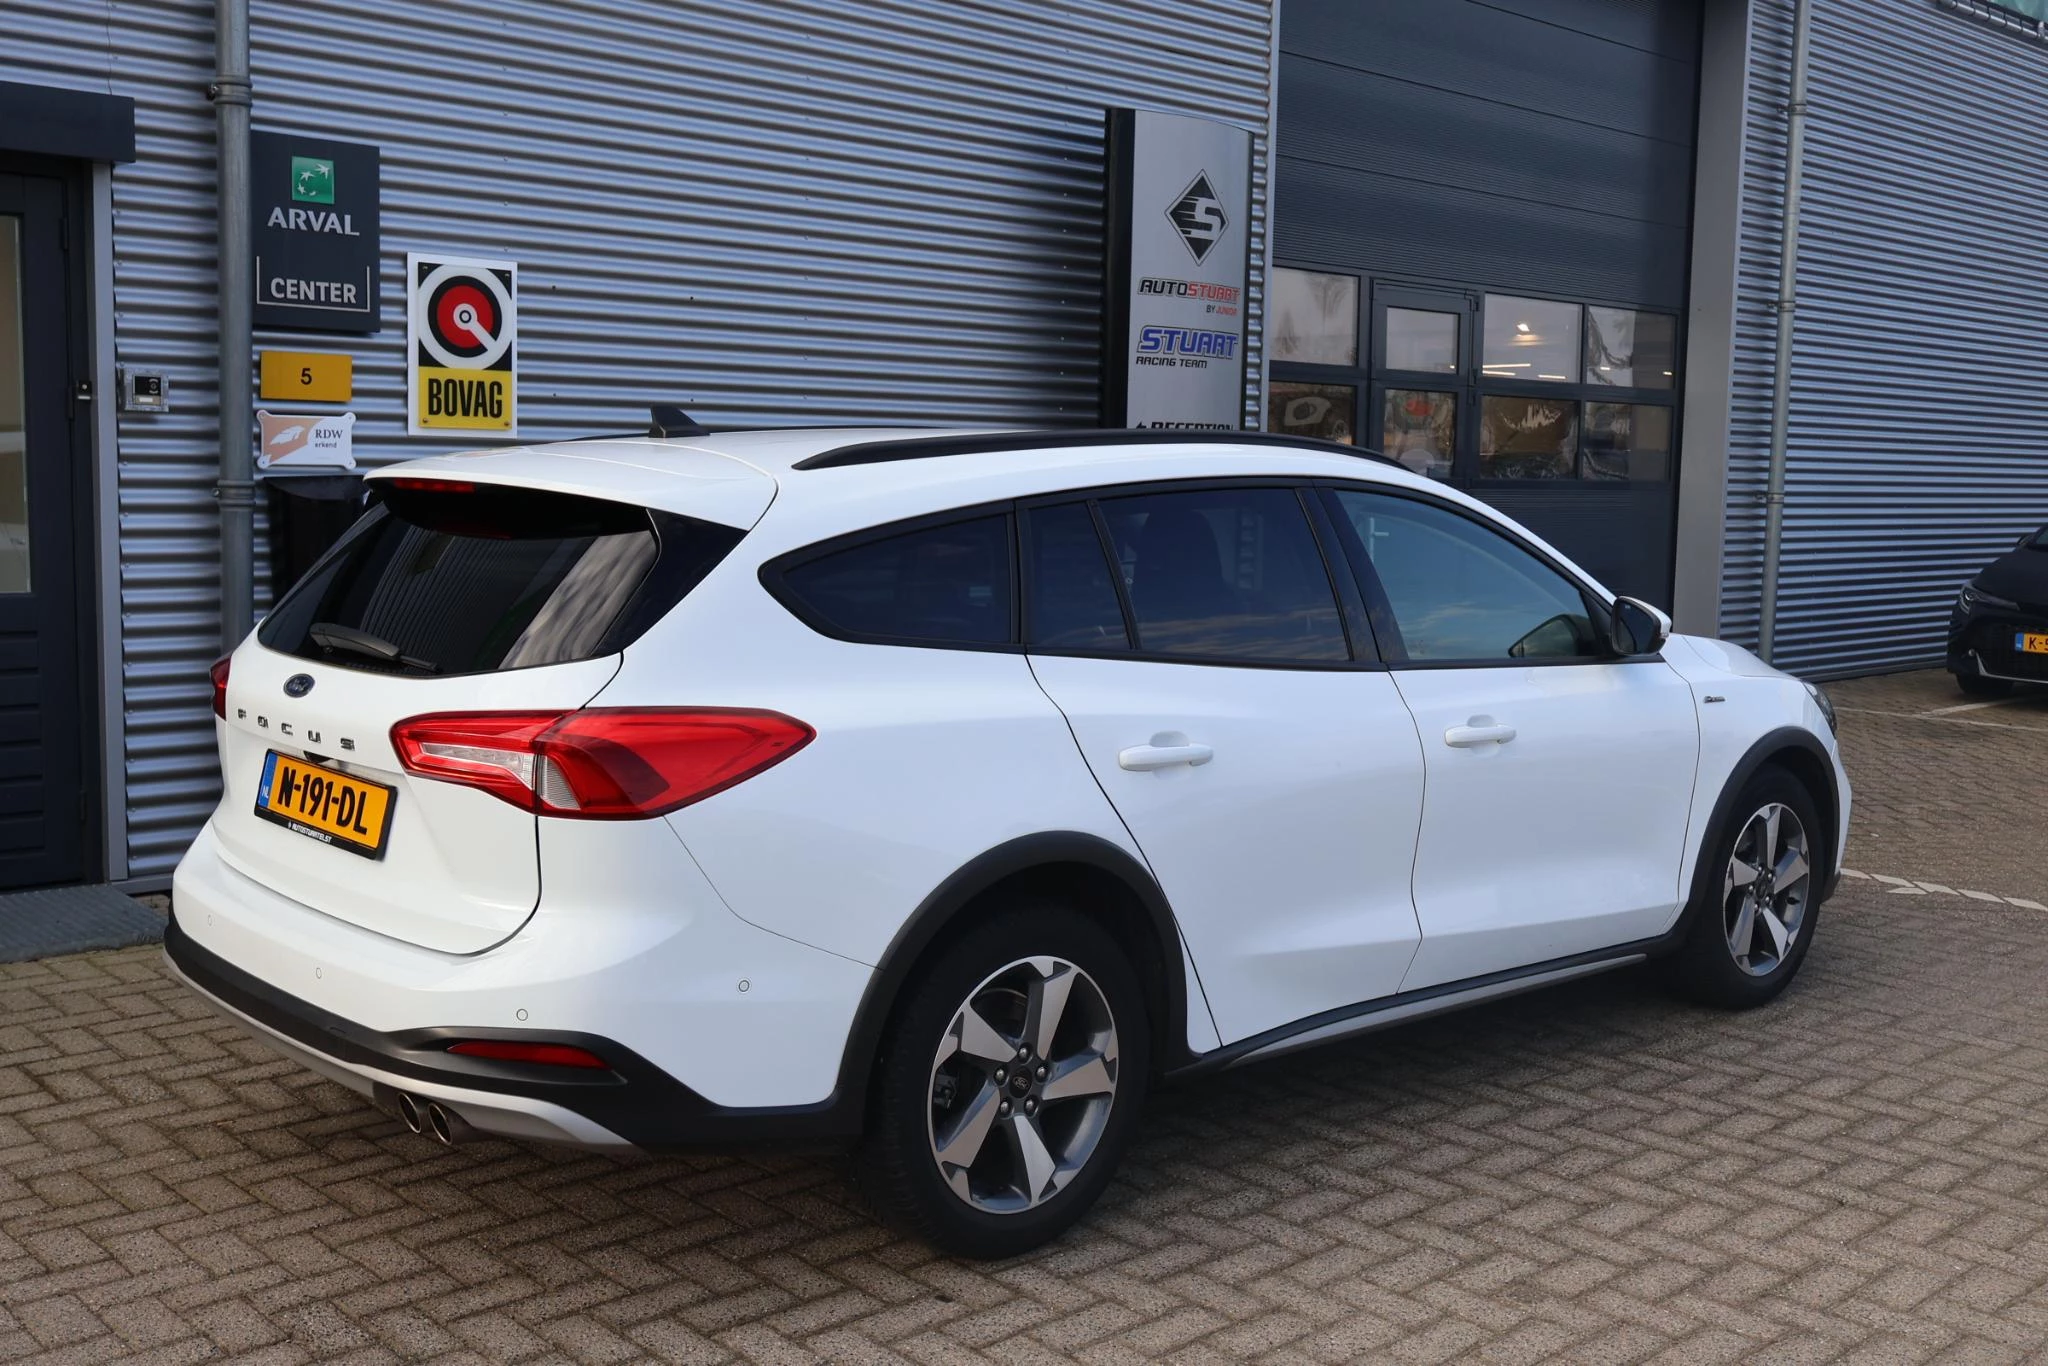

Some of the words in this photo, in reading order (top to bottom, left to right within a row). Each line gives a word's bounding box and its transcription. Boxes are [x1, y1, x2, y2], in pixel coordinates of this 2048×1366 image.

[267, 207, 360, 236] ARVAL
[270, 277, 357, 304] CENTER
[1138, 278, 1240, 303] AUTOSTUART
[1206, 304, 1216, 313] BY
[1138, 326, 1239, 359] STUART
[1136, 356, 1176, 367] RACING
[1179, 358, 1208, 369] TEAM
[300, 368, 313, 386] 5
[427, 377, 503, 419] BOVAG
[315, 429, 344, 439] RDW
[237, 708, 356, 751] FOCUS
[277, 766, 368, 836] N-191-DL
